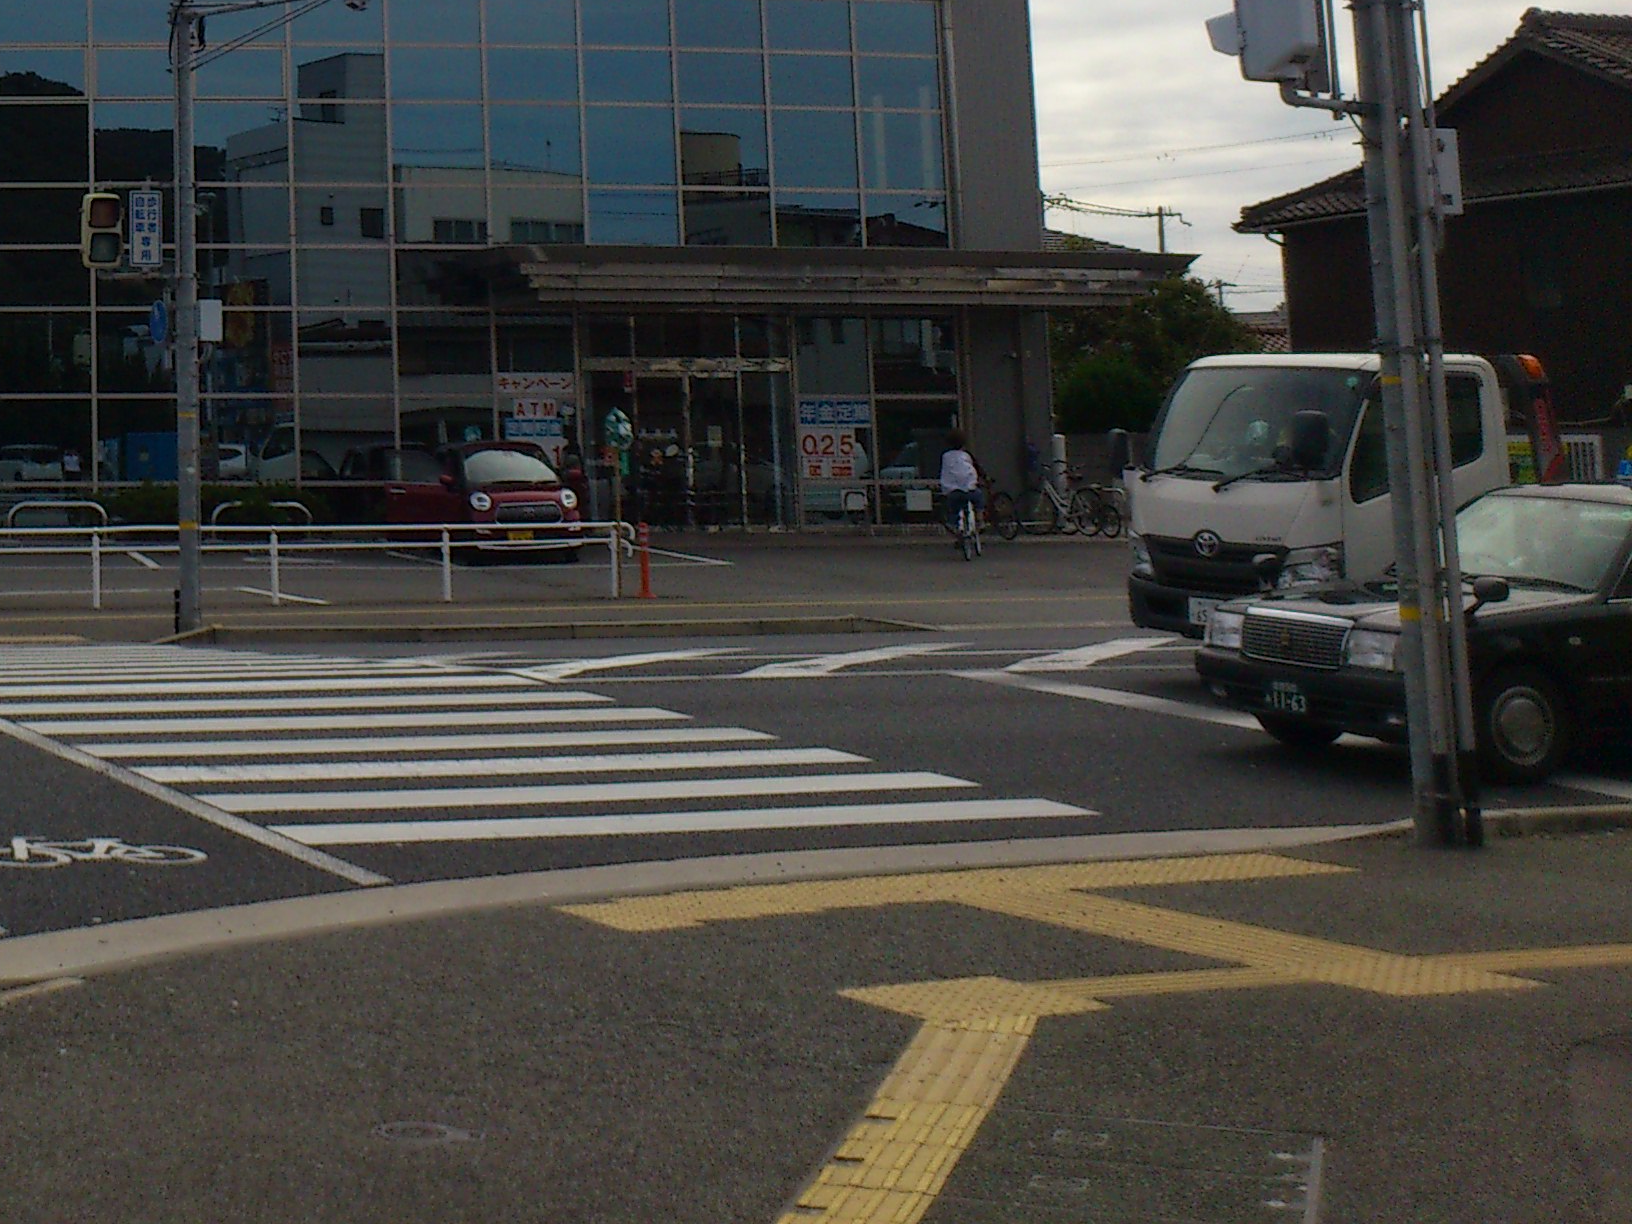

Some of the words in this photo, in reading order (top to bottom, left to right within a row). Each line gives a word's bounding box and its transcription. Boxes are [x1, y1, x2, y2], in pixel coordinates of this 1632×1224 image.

[135, 196, 146, 233] 自転車
[498, 376, 572, 390] キャンペーン
[516, 402, 554, 416] ATM
